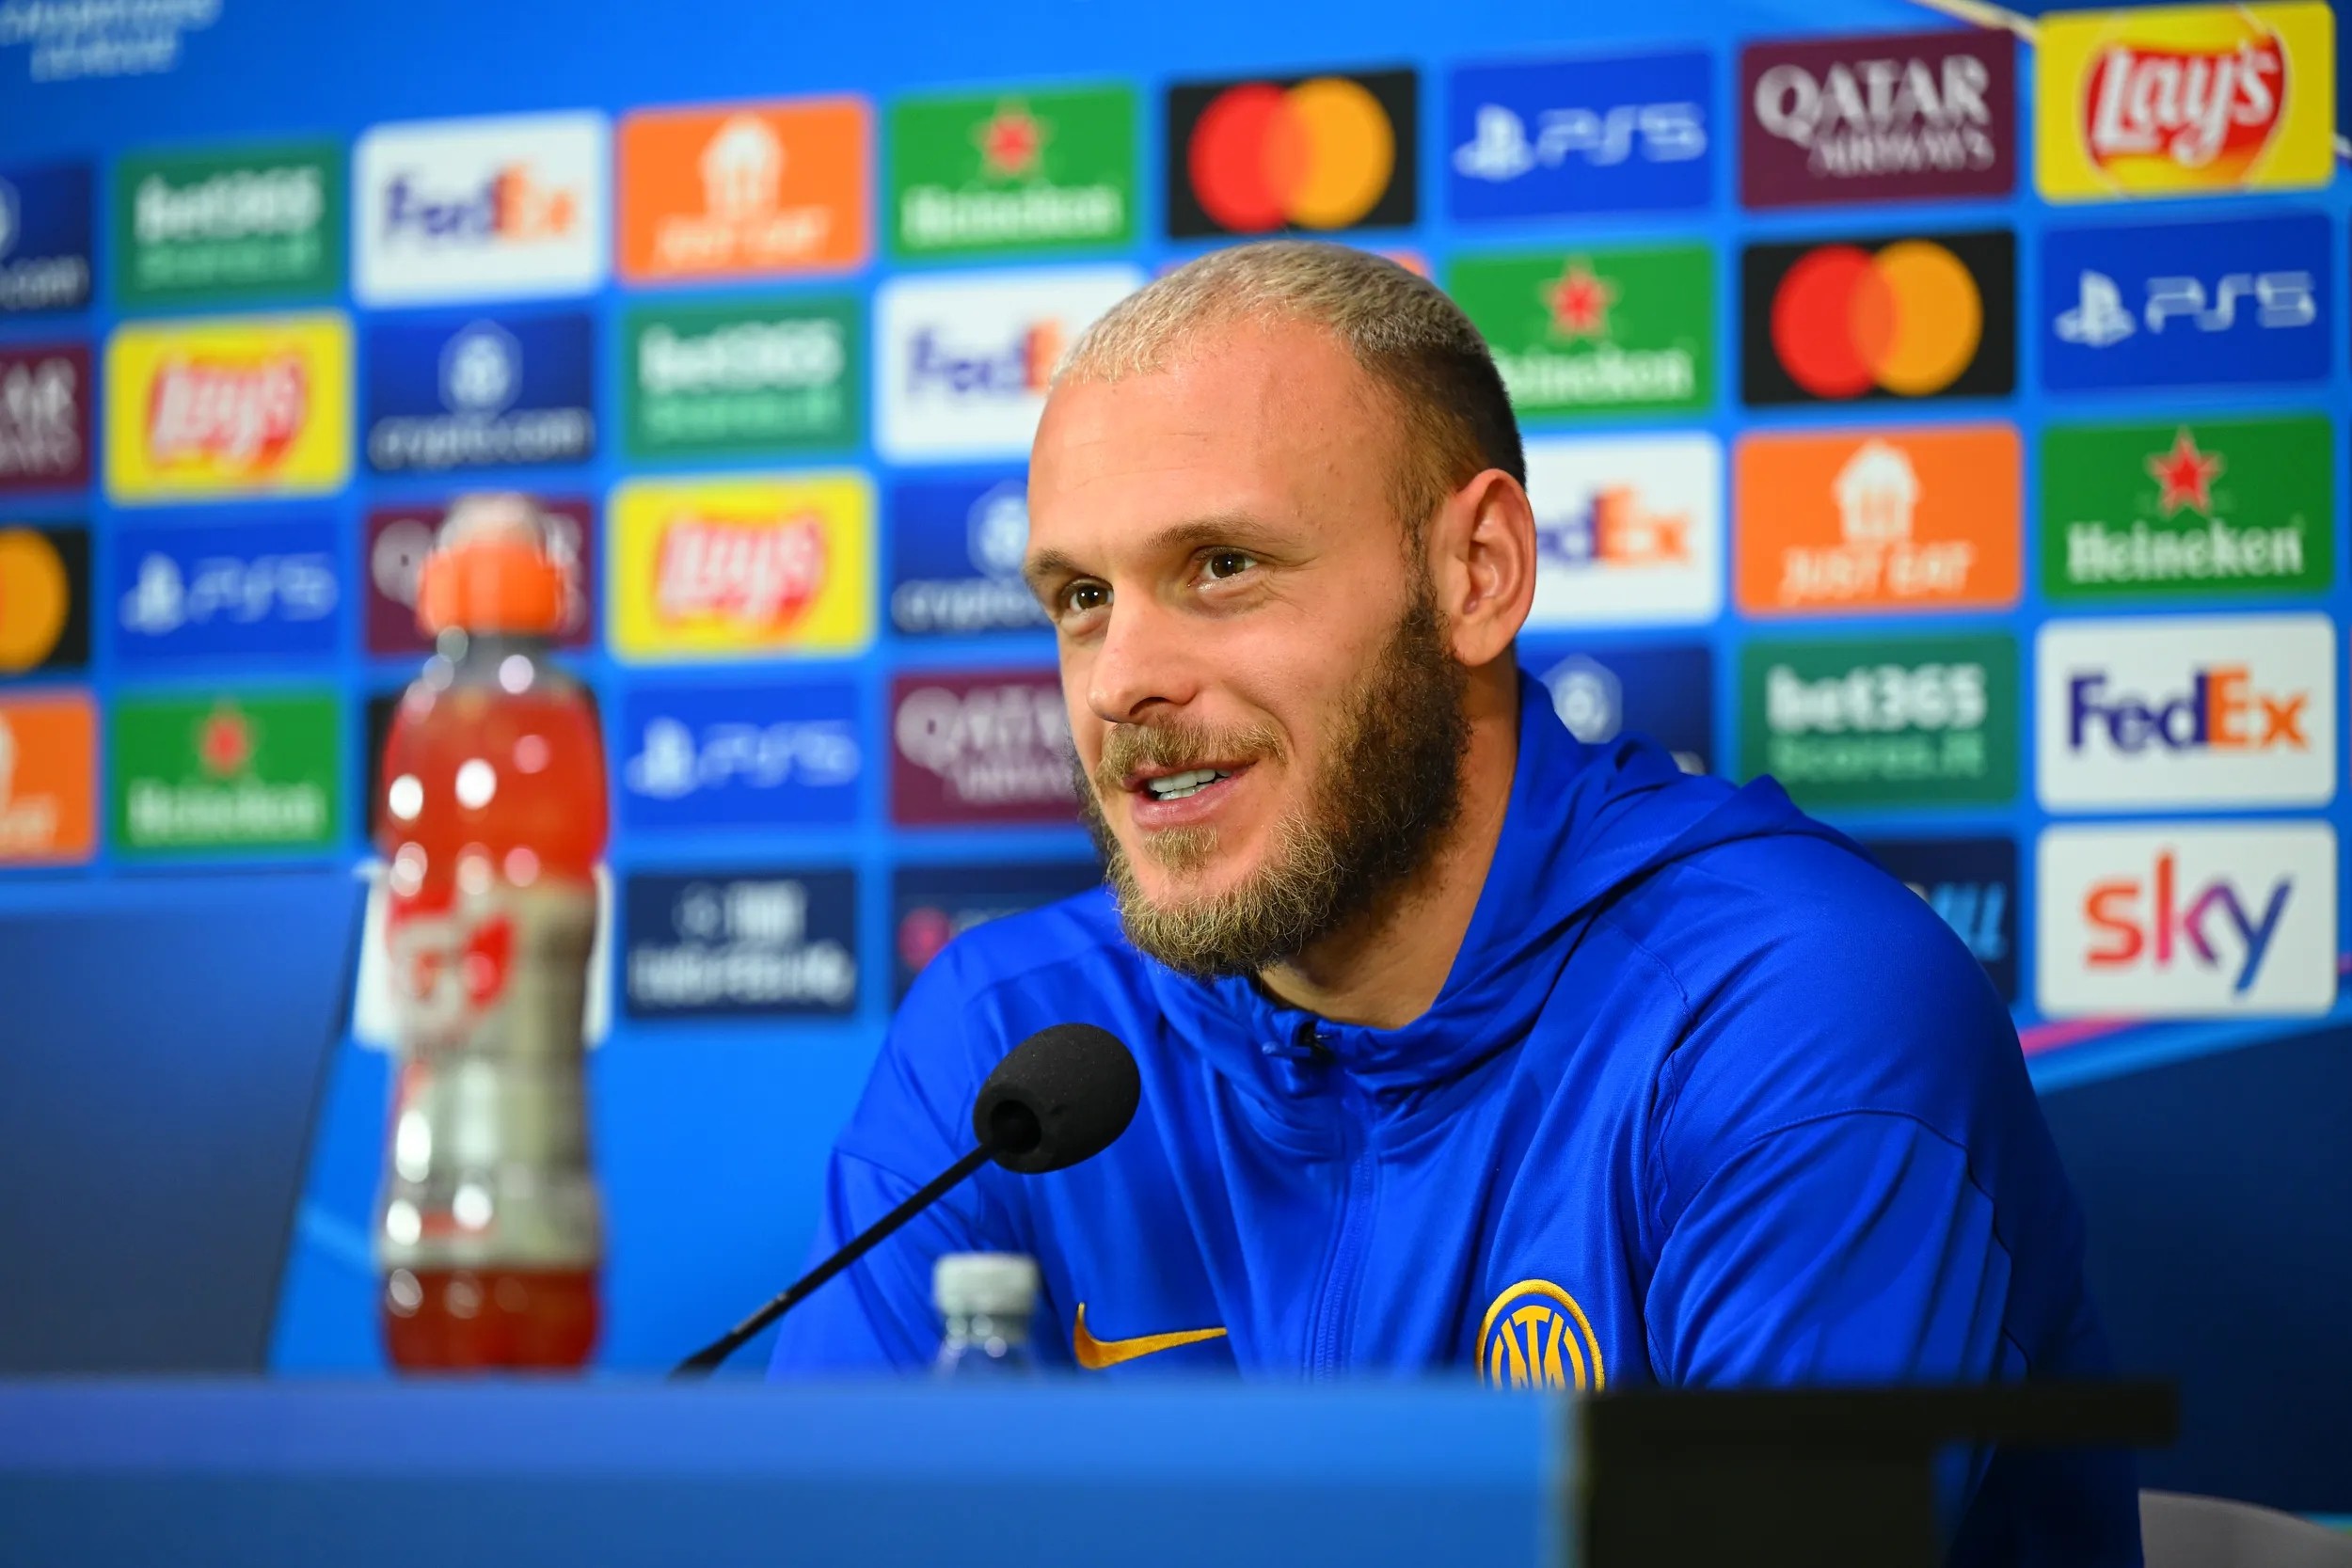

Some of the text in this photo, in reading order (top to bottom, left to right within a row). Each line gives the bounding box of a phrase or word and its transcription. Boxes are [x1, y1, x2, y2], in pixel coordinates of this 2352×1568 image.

[1754, 54, 1992, 148] QATAR
[2090, 39, 2282, 168] Lay's
[1807, 126, 1994, 178] AIRWAYS
[383, 164, 576, 249] FedEx
[898, 185, 1124, 247] Heineken
[2145, 270, 2316, 333] PS5
[907, 317, 1061, 402] FedE
[1496, 341, 1696, 406] eineken
[1781, 540, 1977, 605] JUST EAT
[2066, 517, 2305, 584] Heineken
[1766, 663, 1985, 731] bet365
[2067, 664, 2309, 752] FedEx
[2082, 847, 2294, 996] sky
